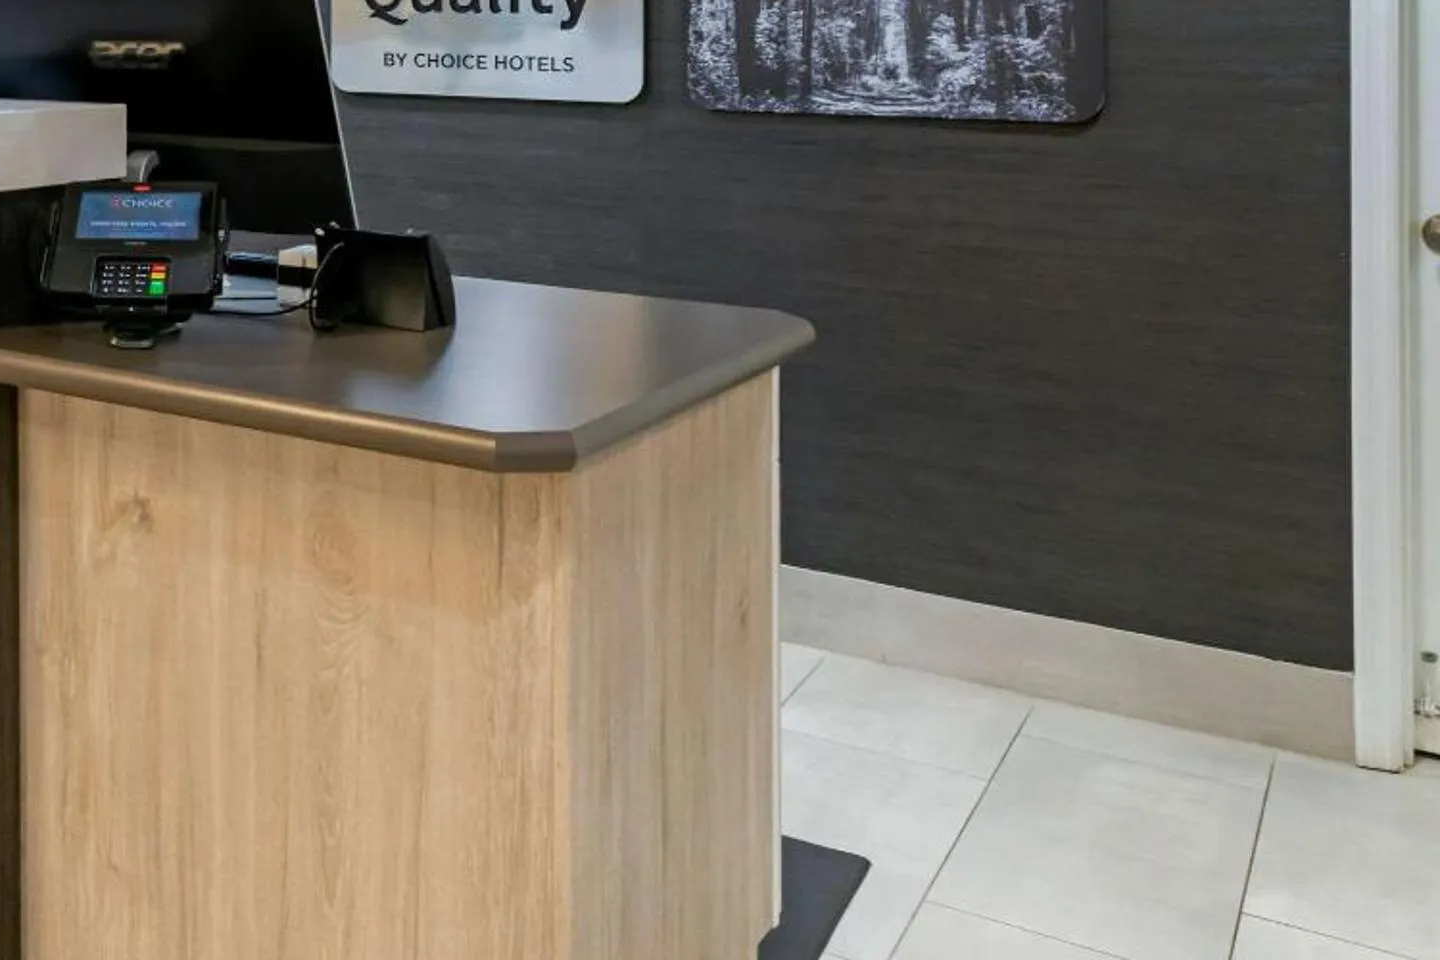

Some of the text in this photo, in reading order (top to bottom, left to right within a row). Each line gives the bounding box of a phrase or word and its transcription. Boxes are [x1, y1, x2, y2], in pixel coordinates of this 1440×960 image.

[383, 52, 575, 73] BY CHOICE HOTELS
